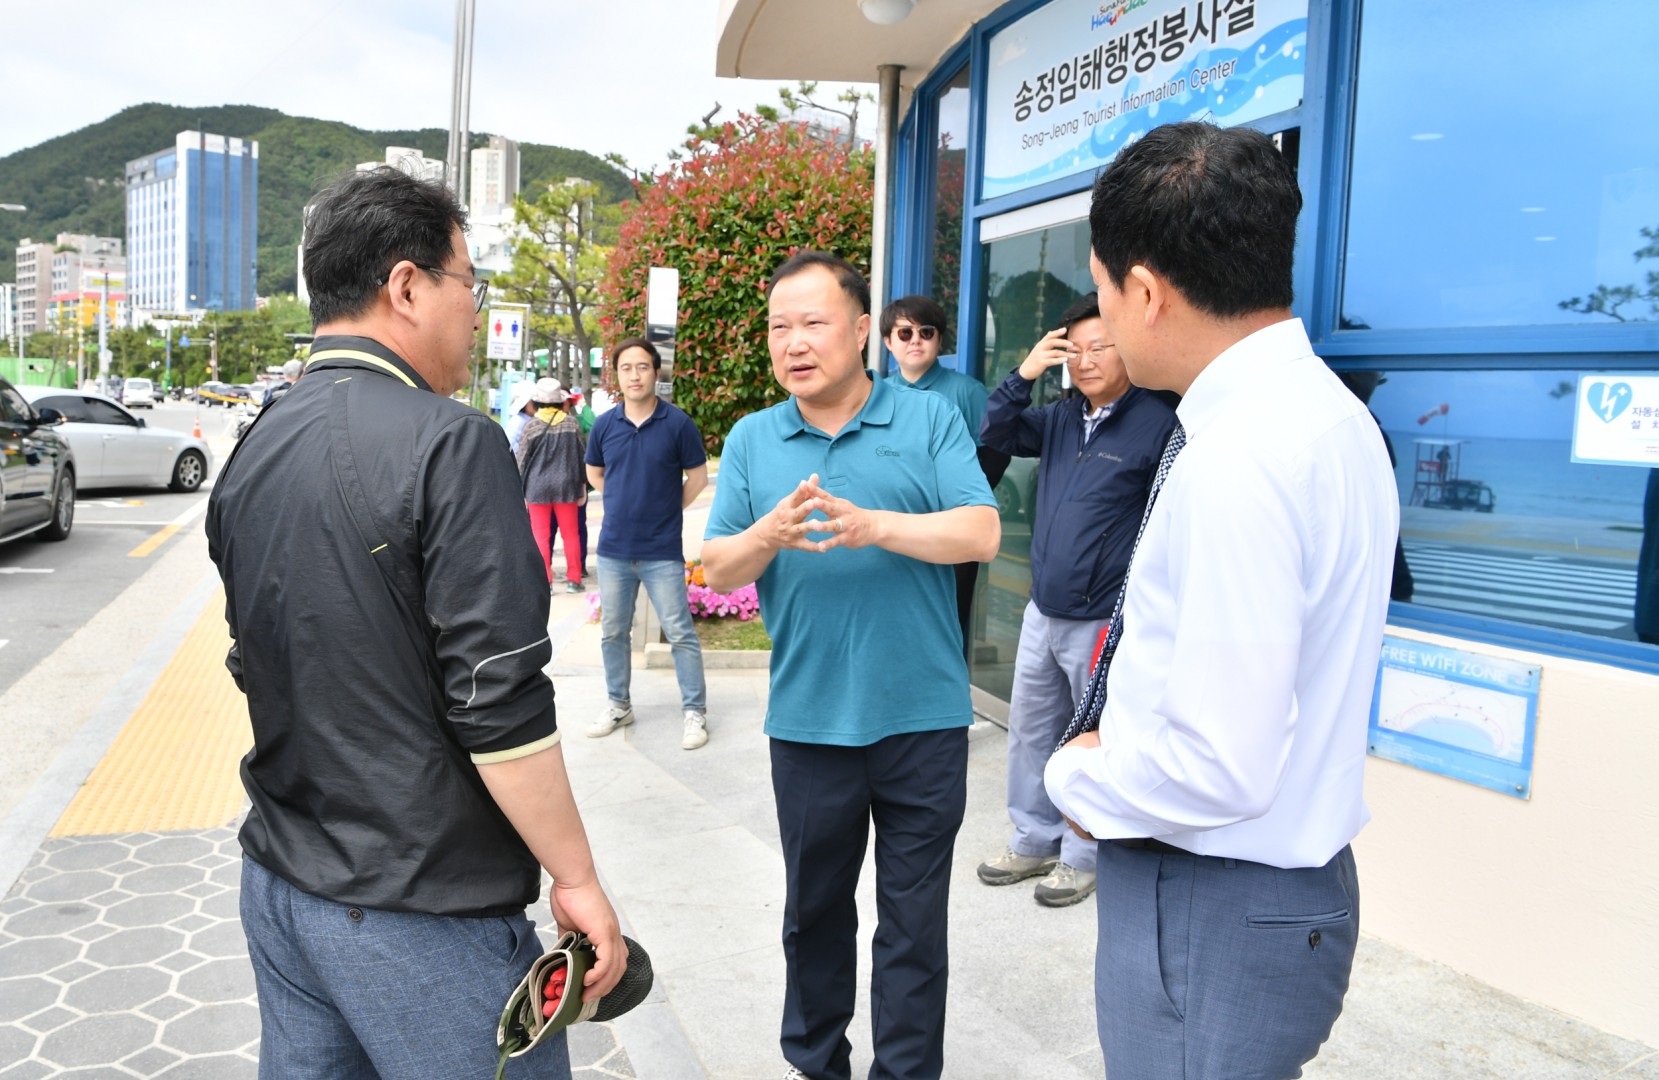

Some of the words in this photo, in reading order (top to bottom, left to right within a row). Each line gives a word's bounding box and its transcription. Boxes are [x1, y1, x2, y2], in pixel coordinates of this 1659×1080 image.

[1014, 0, 1255, 122] 송정임해행정봉사실
[1022, 119, 1079, 151] Song-Jeong
[1083, 101, 1116, 127] Tourist
[1120, 78, 1186, 115] Information
[1190, 59, 1237, 89] Center
[1381, 645, 1417, 665] FREE
